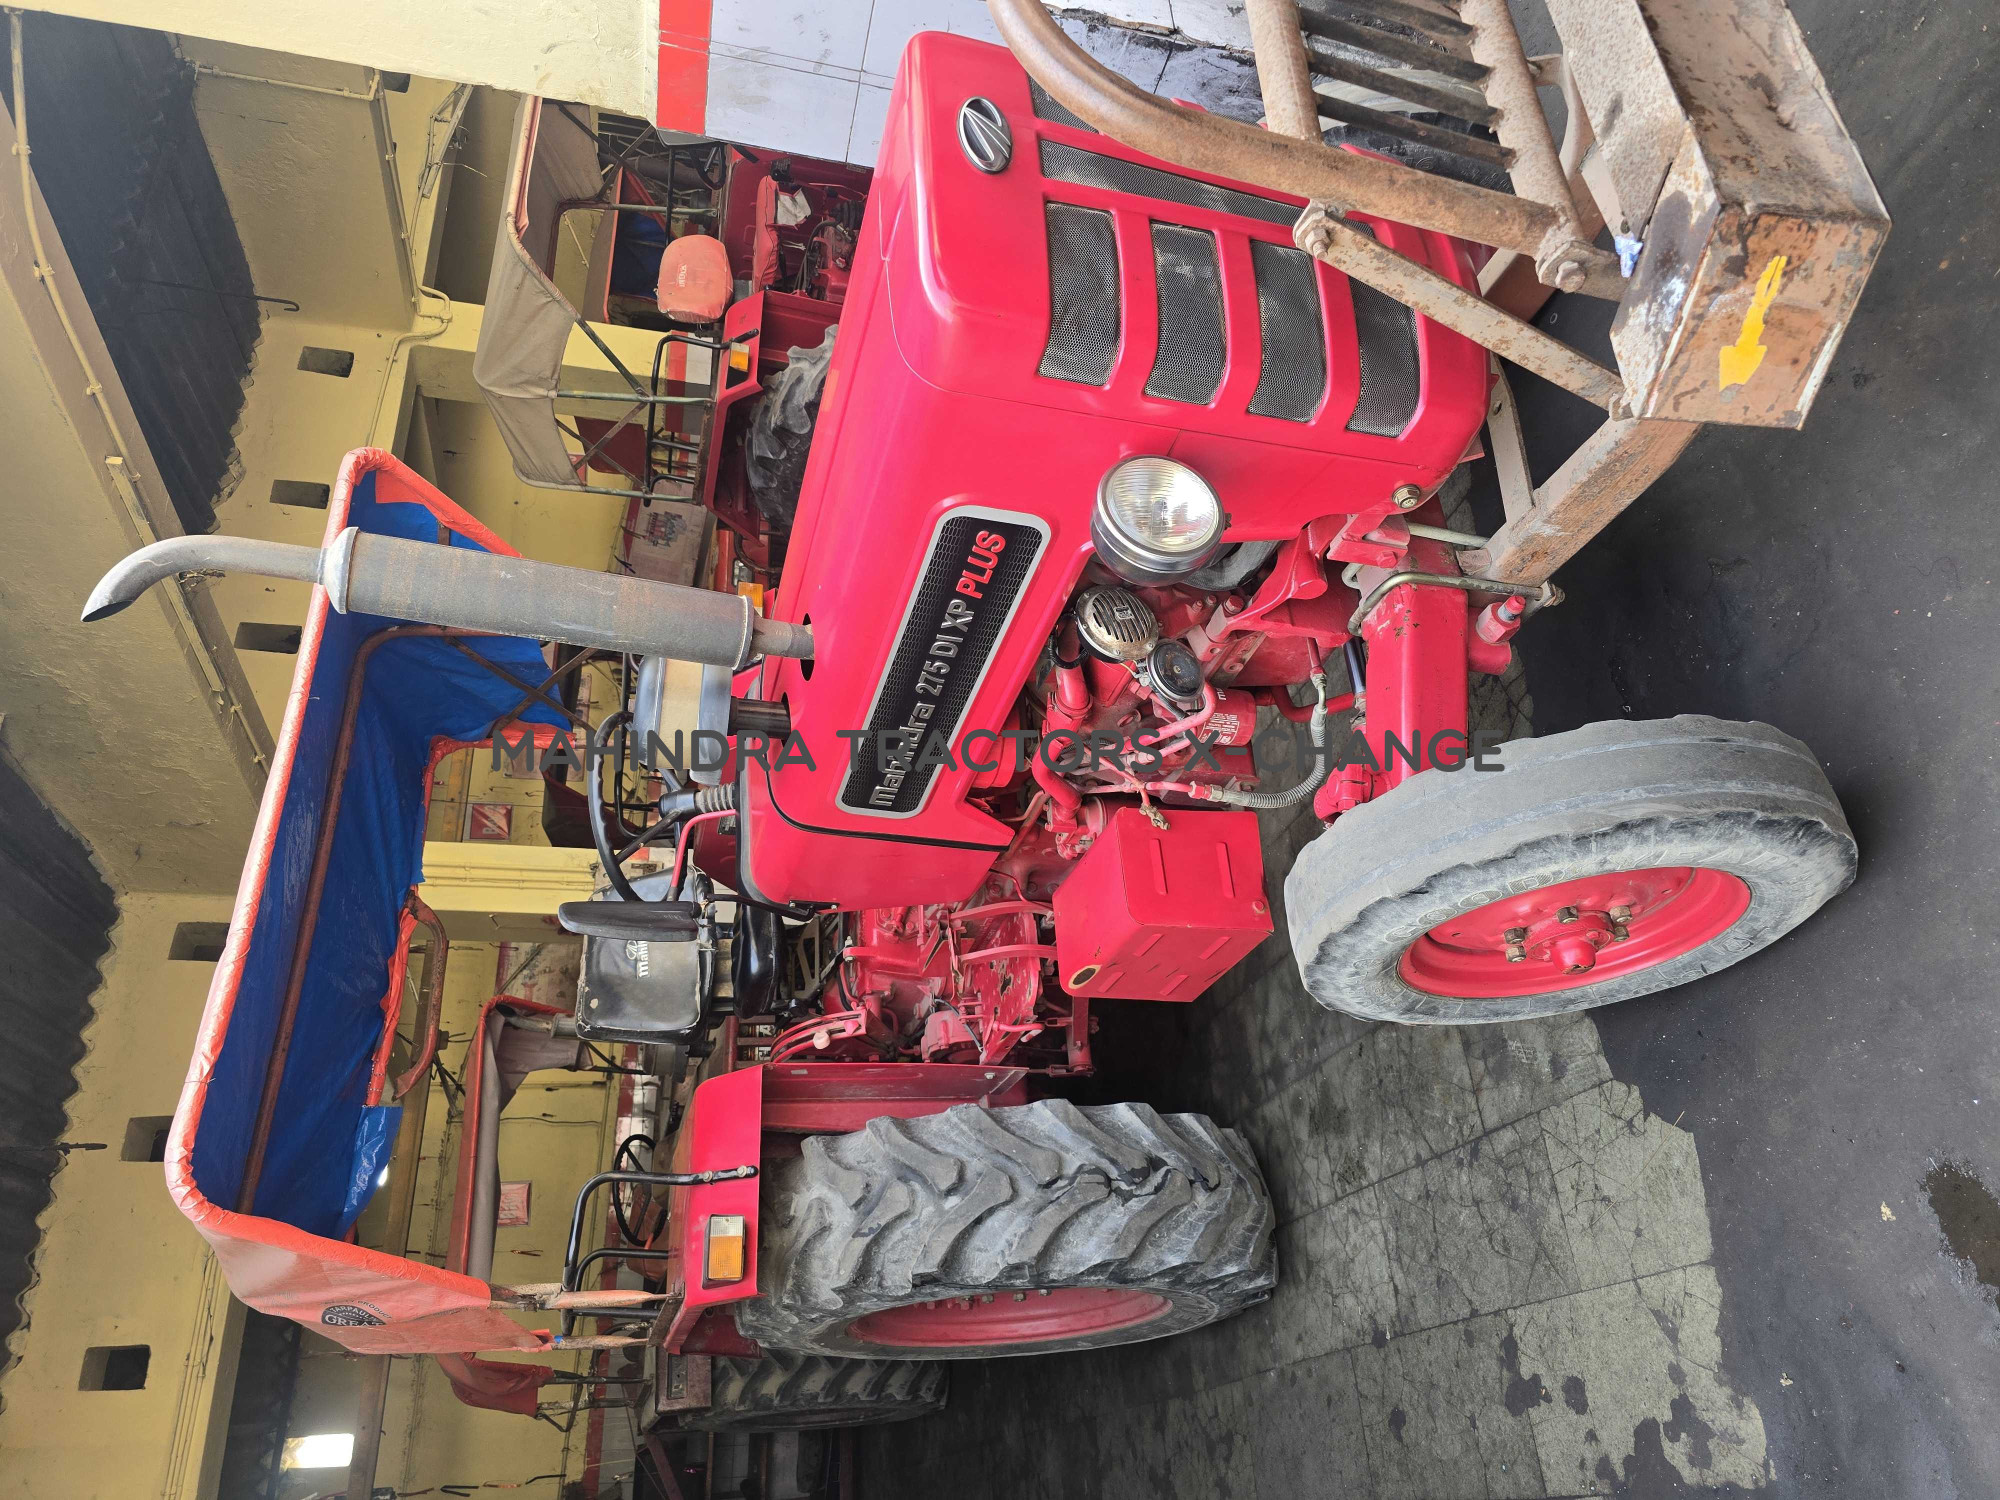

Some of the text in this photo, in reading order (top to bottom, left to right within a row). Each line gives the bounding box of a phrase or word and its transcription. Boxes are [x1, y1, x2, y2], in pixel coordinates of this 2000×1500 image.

[955, 530, 1007, 600] PLUS
[940, 599, 975, 633] XP
[929, 634, 964, 658] DI
[915, 660, 951, 697] 275
